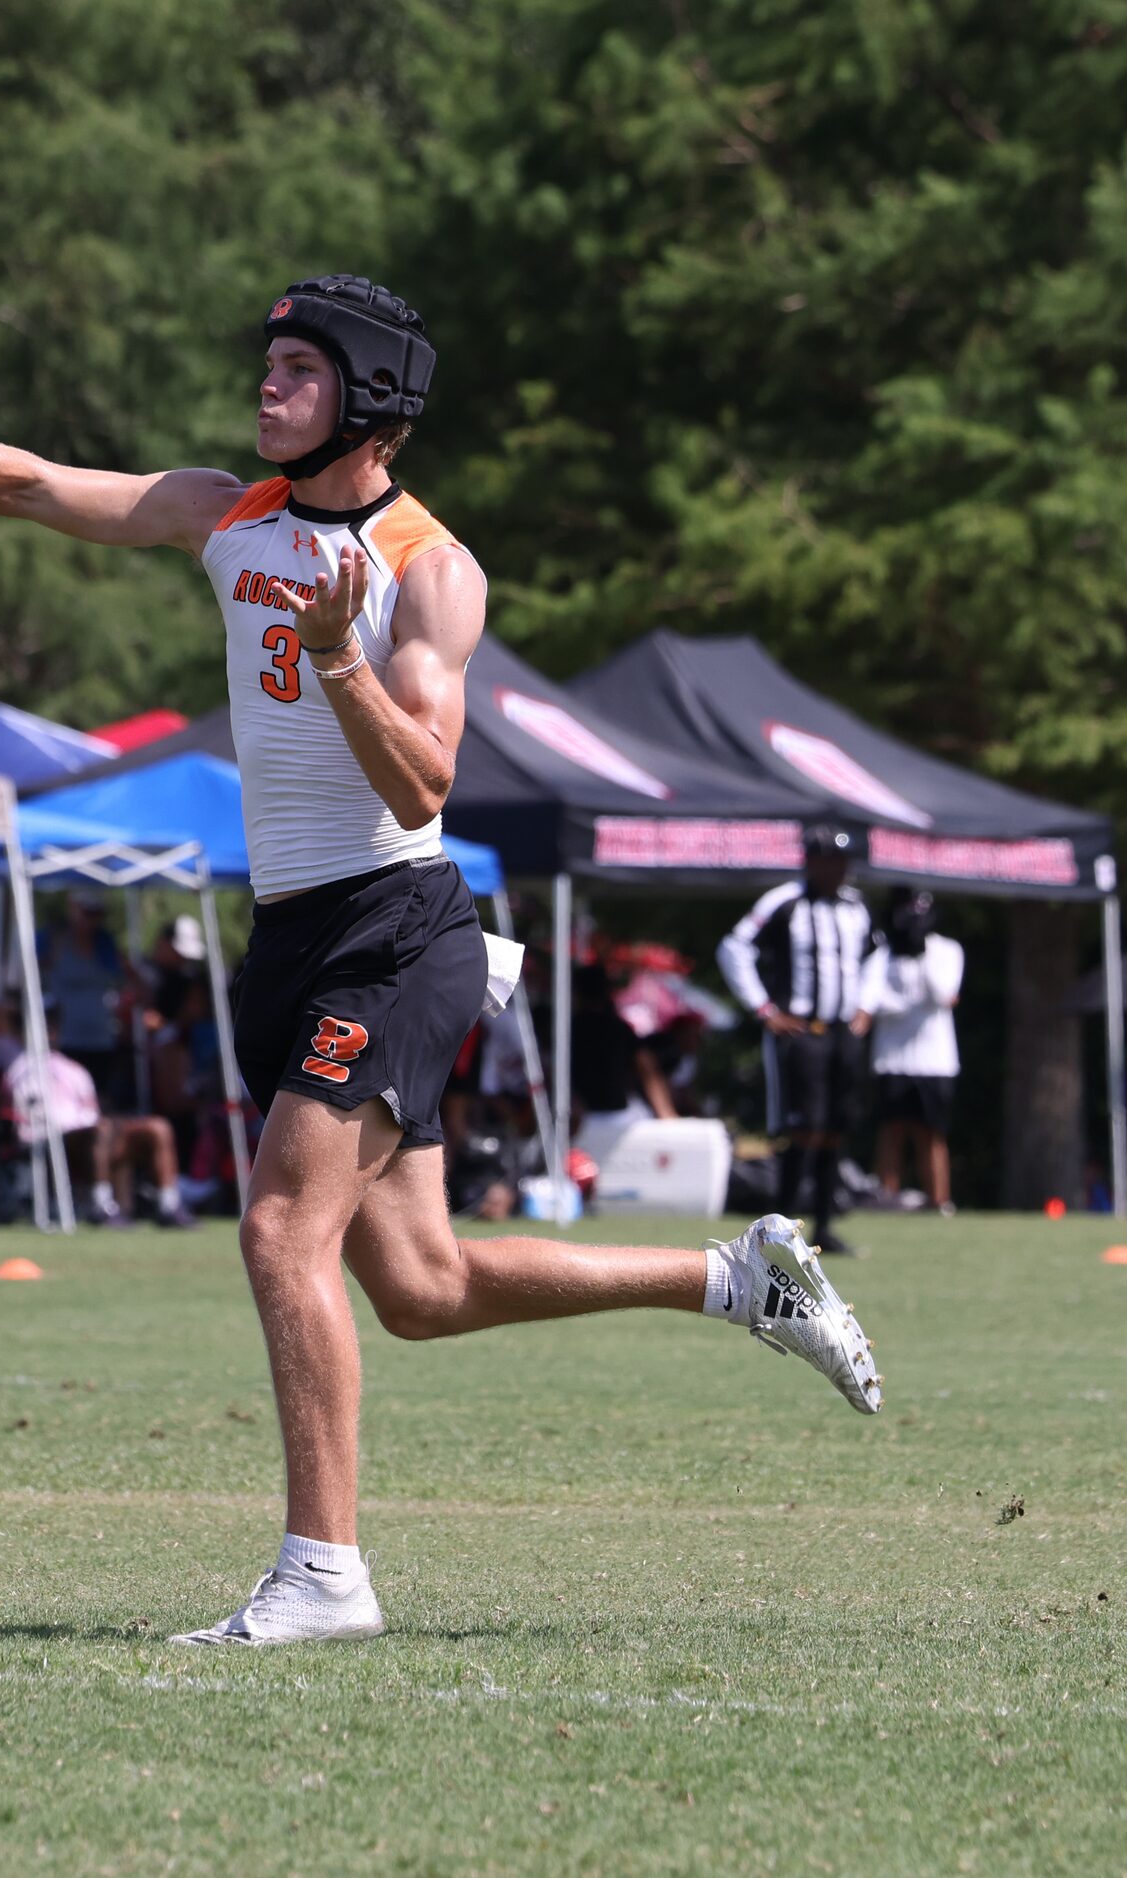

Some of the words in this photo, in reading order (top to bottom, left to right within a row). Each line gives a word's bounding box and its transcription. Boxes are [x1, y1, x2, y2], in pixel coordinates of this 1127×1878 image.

[233, 569, 316, 611] ROCKW
[260, 624, 302, 704] 3
[767, 1264, 823, 1317] adidas
